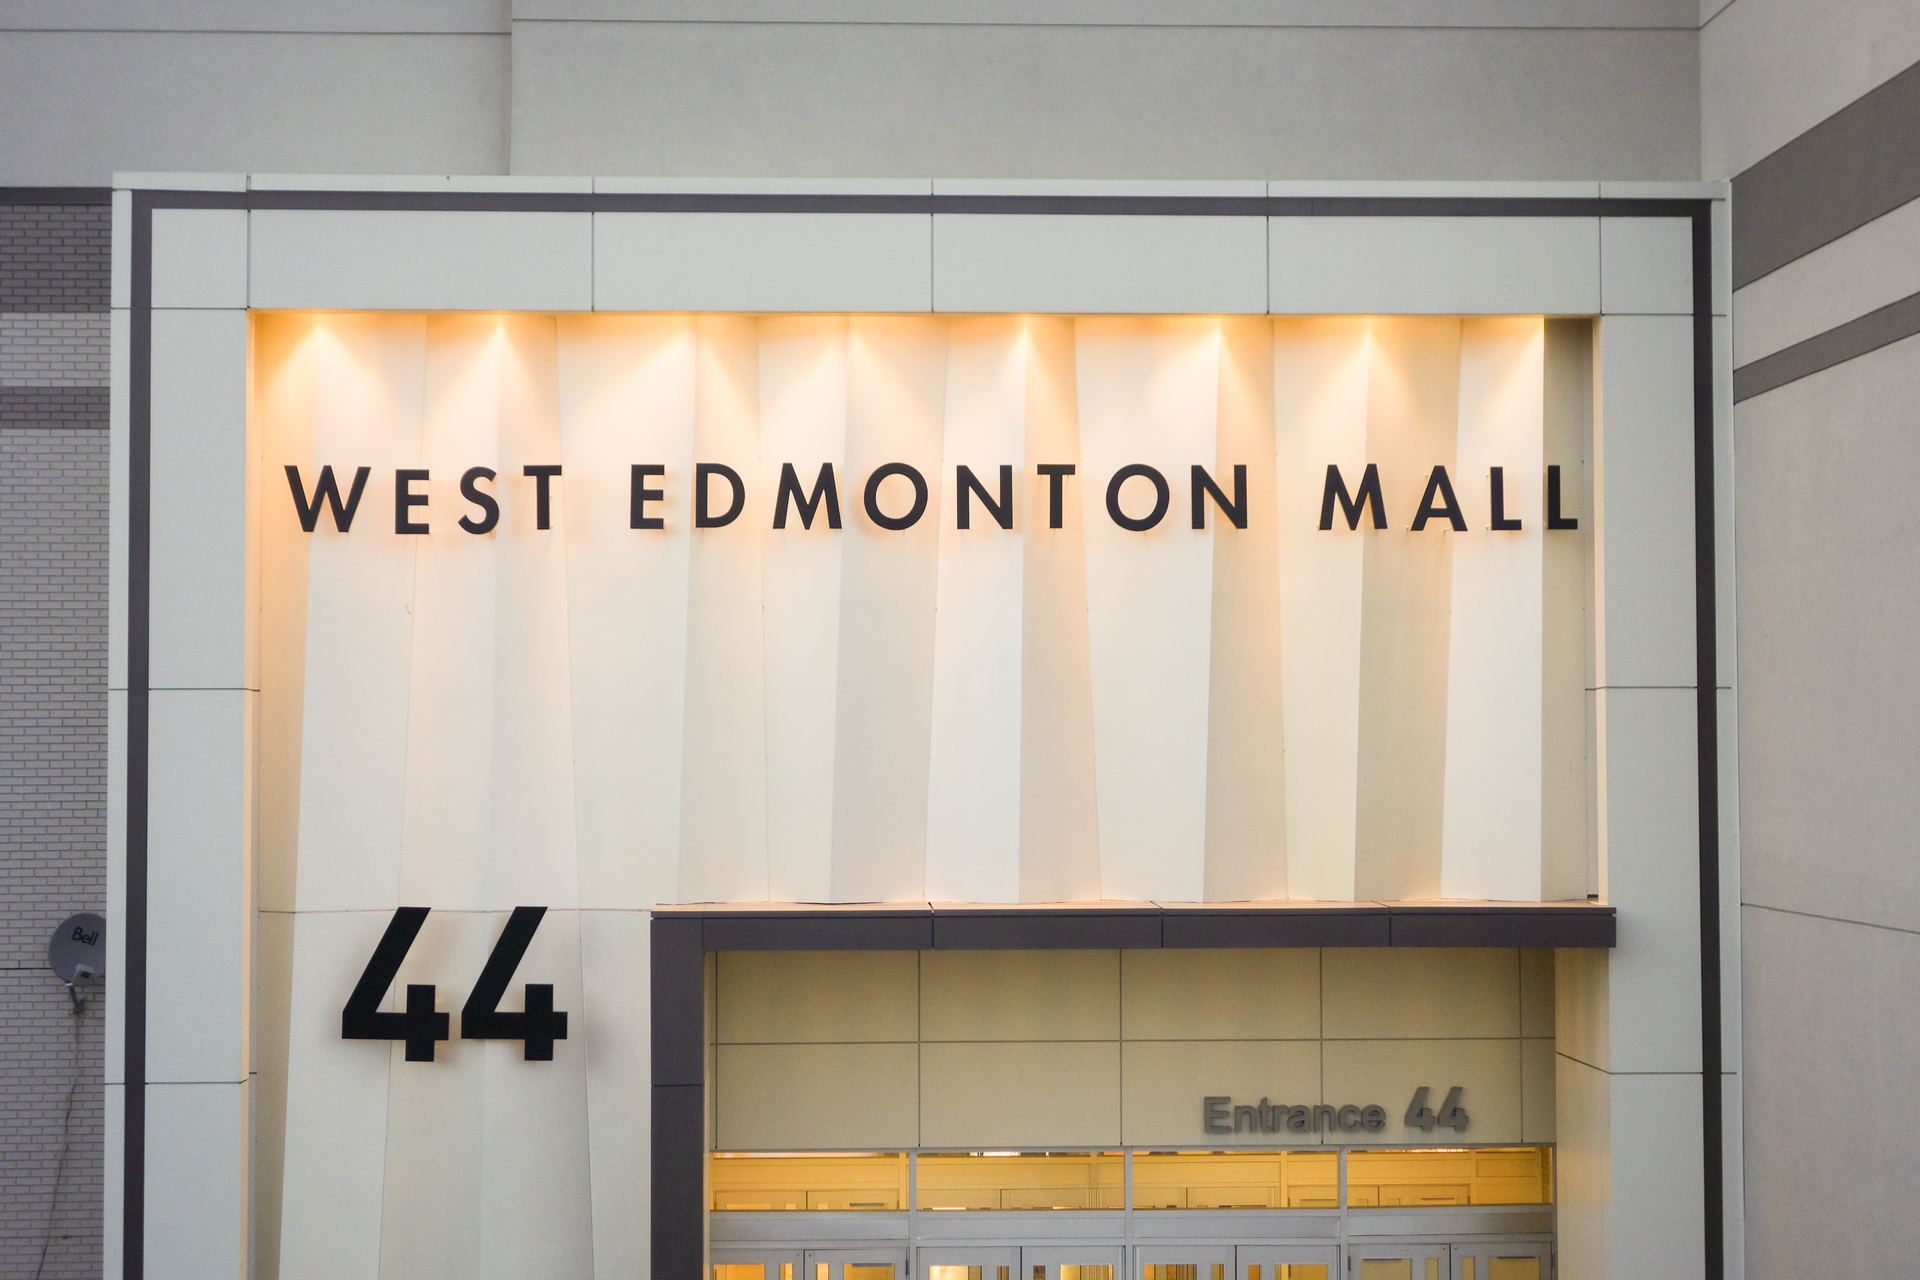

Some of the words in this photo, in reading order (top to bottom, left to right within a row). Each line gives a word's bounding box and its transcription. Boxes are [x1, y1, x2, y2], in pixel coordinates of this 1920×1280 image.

[285, 465, 562, 534] WEST
[631, 463, 1247, 531] EDMONTON
[1319, 464, 1579, 532] MALL
[72, 926, 98, 946] Bell
[342, 907, 568, 1062] 44
[1203, 1096, 1386, 1134] Entrance
[1404, 1086, 1470, 1133] 44
